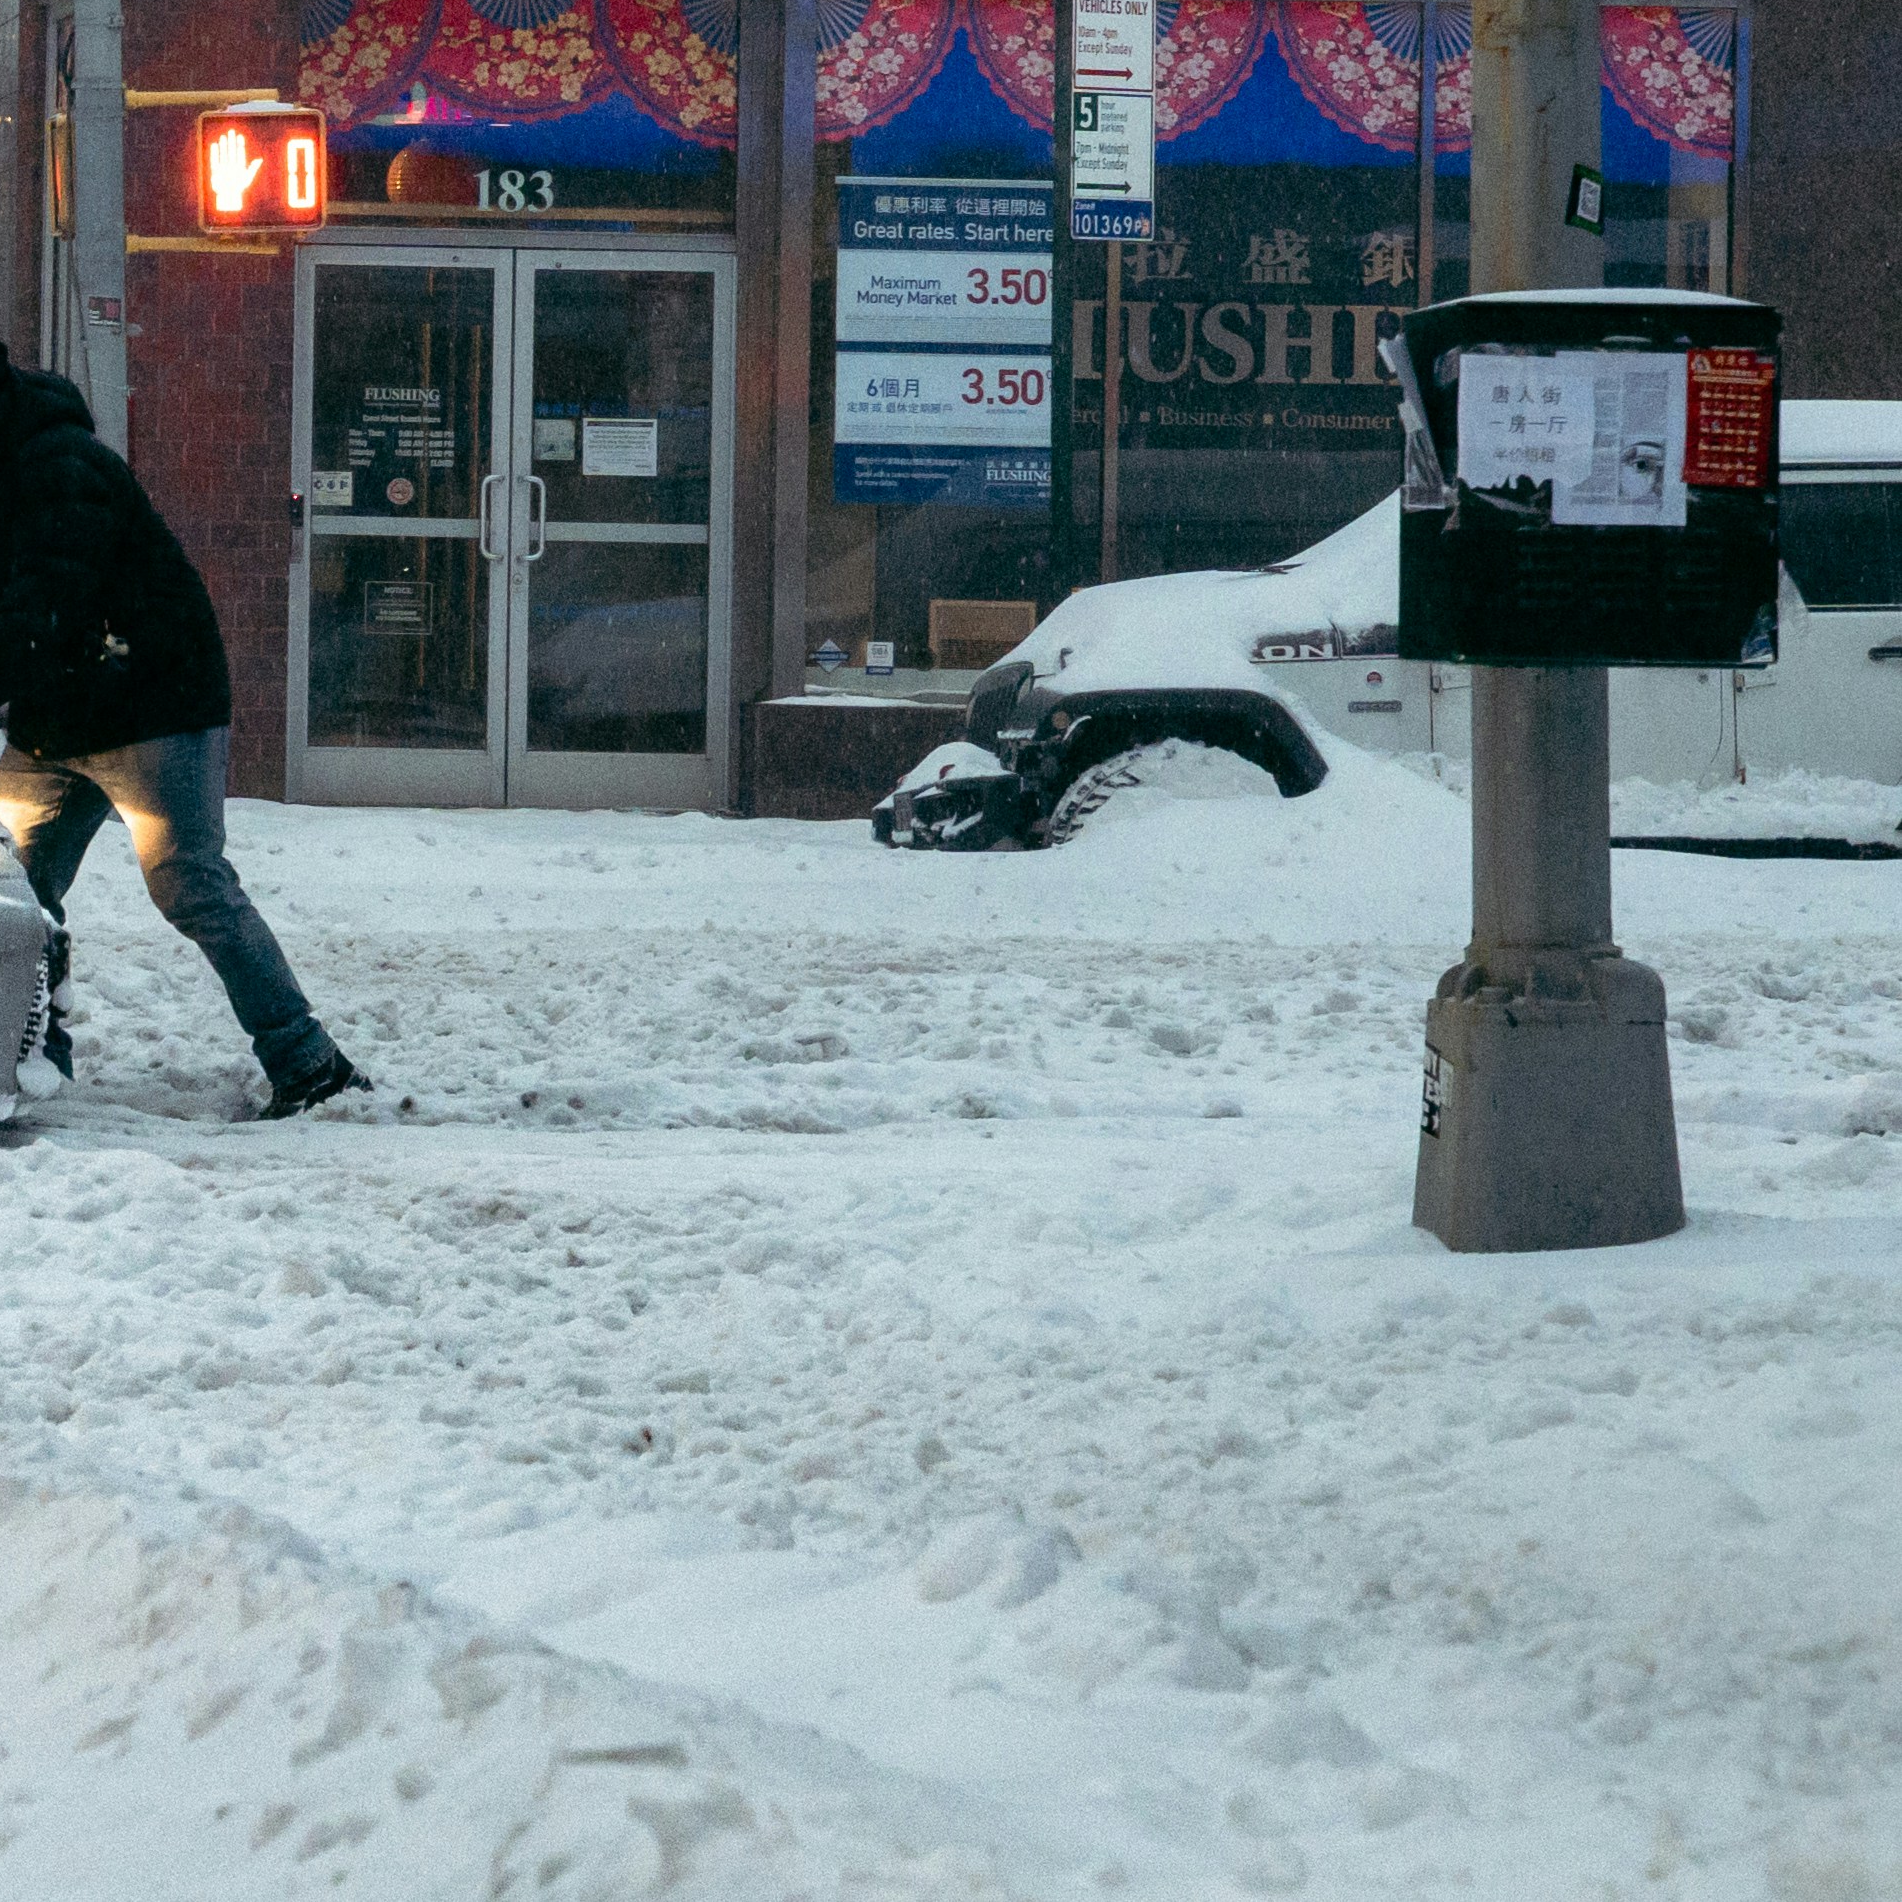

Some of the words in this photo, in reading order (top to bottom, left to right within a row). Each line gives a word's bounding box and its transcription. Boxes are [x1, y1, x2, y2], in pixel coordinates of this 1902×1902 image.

[1125, 1, 1149, 16] ONLY
[1077, 26, 1097, 38] 10am
[1102, 27, 1118, 40] 4pm
[1078, 40, 1104, 55] Except
[1105, 42, 1133, 57] Sunday
[1080, 97, 1093, 128] 5
[1099, 142, 1129, 156] Midnight
[286, 138, 316, 209] 0
[1076, 158, 1100, 171] Except
[1100, 159, 1128, 172] Sunday
[474, 170, 555, 213] 183
[875, 196, 946, 214] 優惠利率
[854, 221, 903, 239] Great
[909, 223, 959, 240] rates.
[964, 222, 1009, 241] Start
[1014, 223, 1053, 242] here
[870, 275, 941, 290] Maximum
[966, 268, 1053, 305] 3.50
[857, 291, 903, 307] Money
[907, 291, 957, 306] Market
[1073, 299, 1414, 387] LUSHI
[364, 387, 441, 401] FLUSHING
[867, 378, 920, 399] 6個月
[961, 368, 1052, 405] 3.50
[1491, 385, 1563, 405] 唐人街
[1157, 405, 1253, 426] Business
[1282, 409, 1396, 430] Consumer
[1490, 414, 1569, 434] 一房一厅
